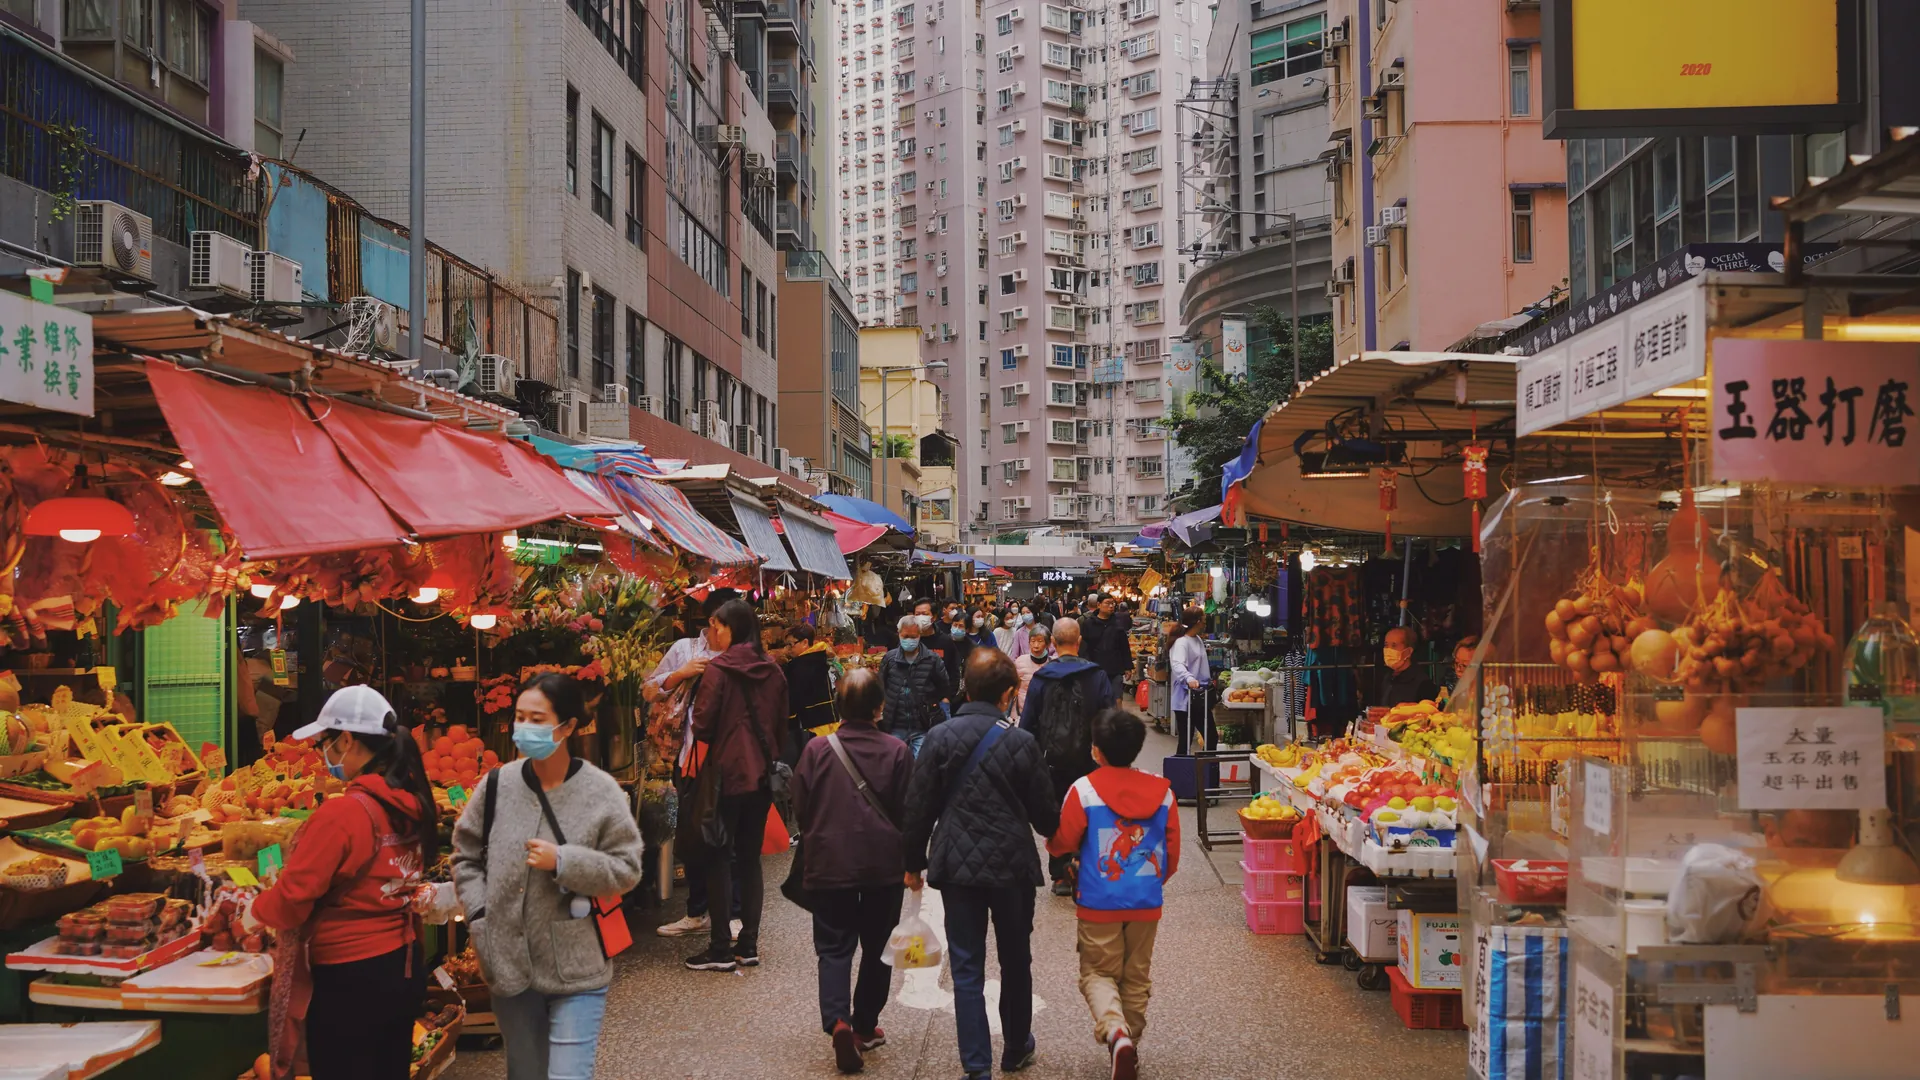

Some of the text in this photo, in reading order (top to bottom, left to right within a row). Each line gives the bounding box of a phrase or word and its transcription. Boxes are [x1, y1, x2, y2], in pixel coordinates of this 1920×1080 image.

[1679, 63, 1712, 76] 2020
[1711, 251, 1746, 265] OCEAN
[1716, 259, 1750, 272] THREE
[1634, 312, 1688, 369] 修理首飾
[1574, 346, 1618, 395] 打磨玉器
[1718, 376, 1914, 448] 玉器打磨
[1787, 726, 1835, 744] 大量
[1762, 751, 1861, 767] 玉石原料
[1761, 773, 1859, 791] 超平出售
[1425, 921, 1448, 929] FUJI
